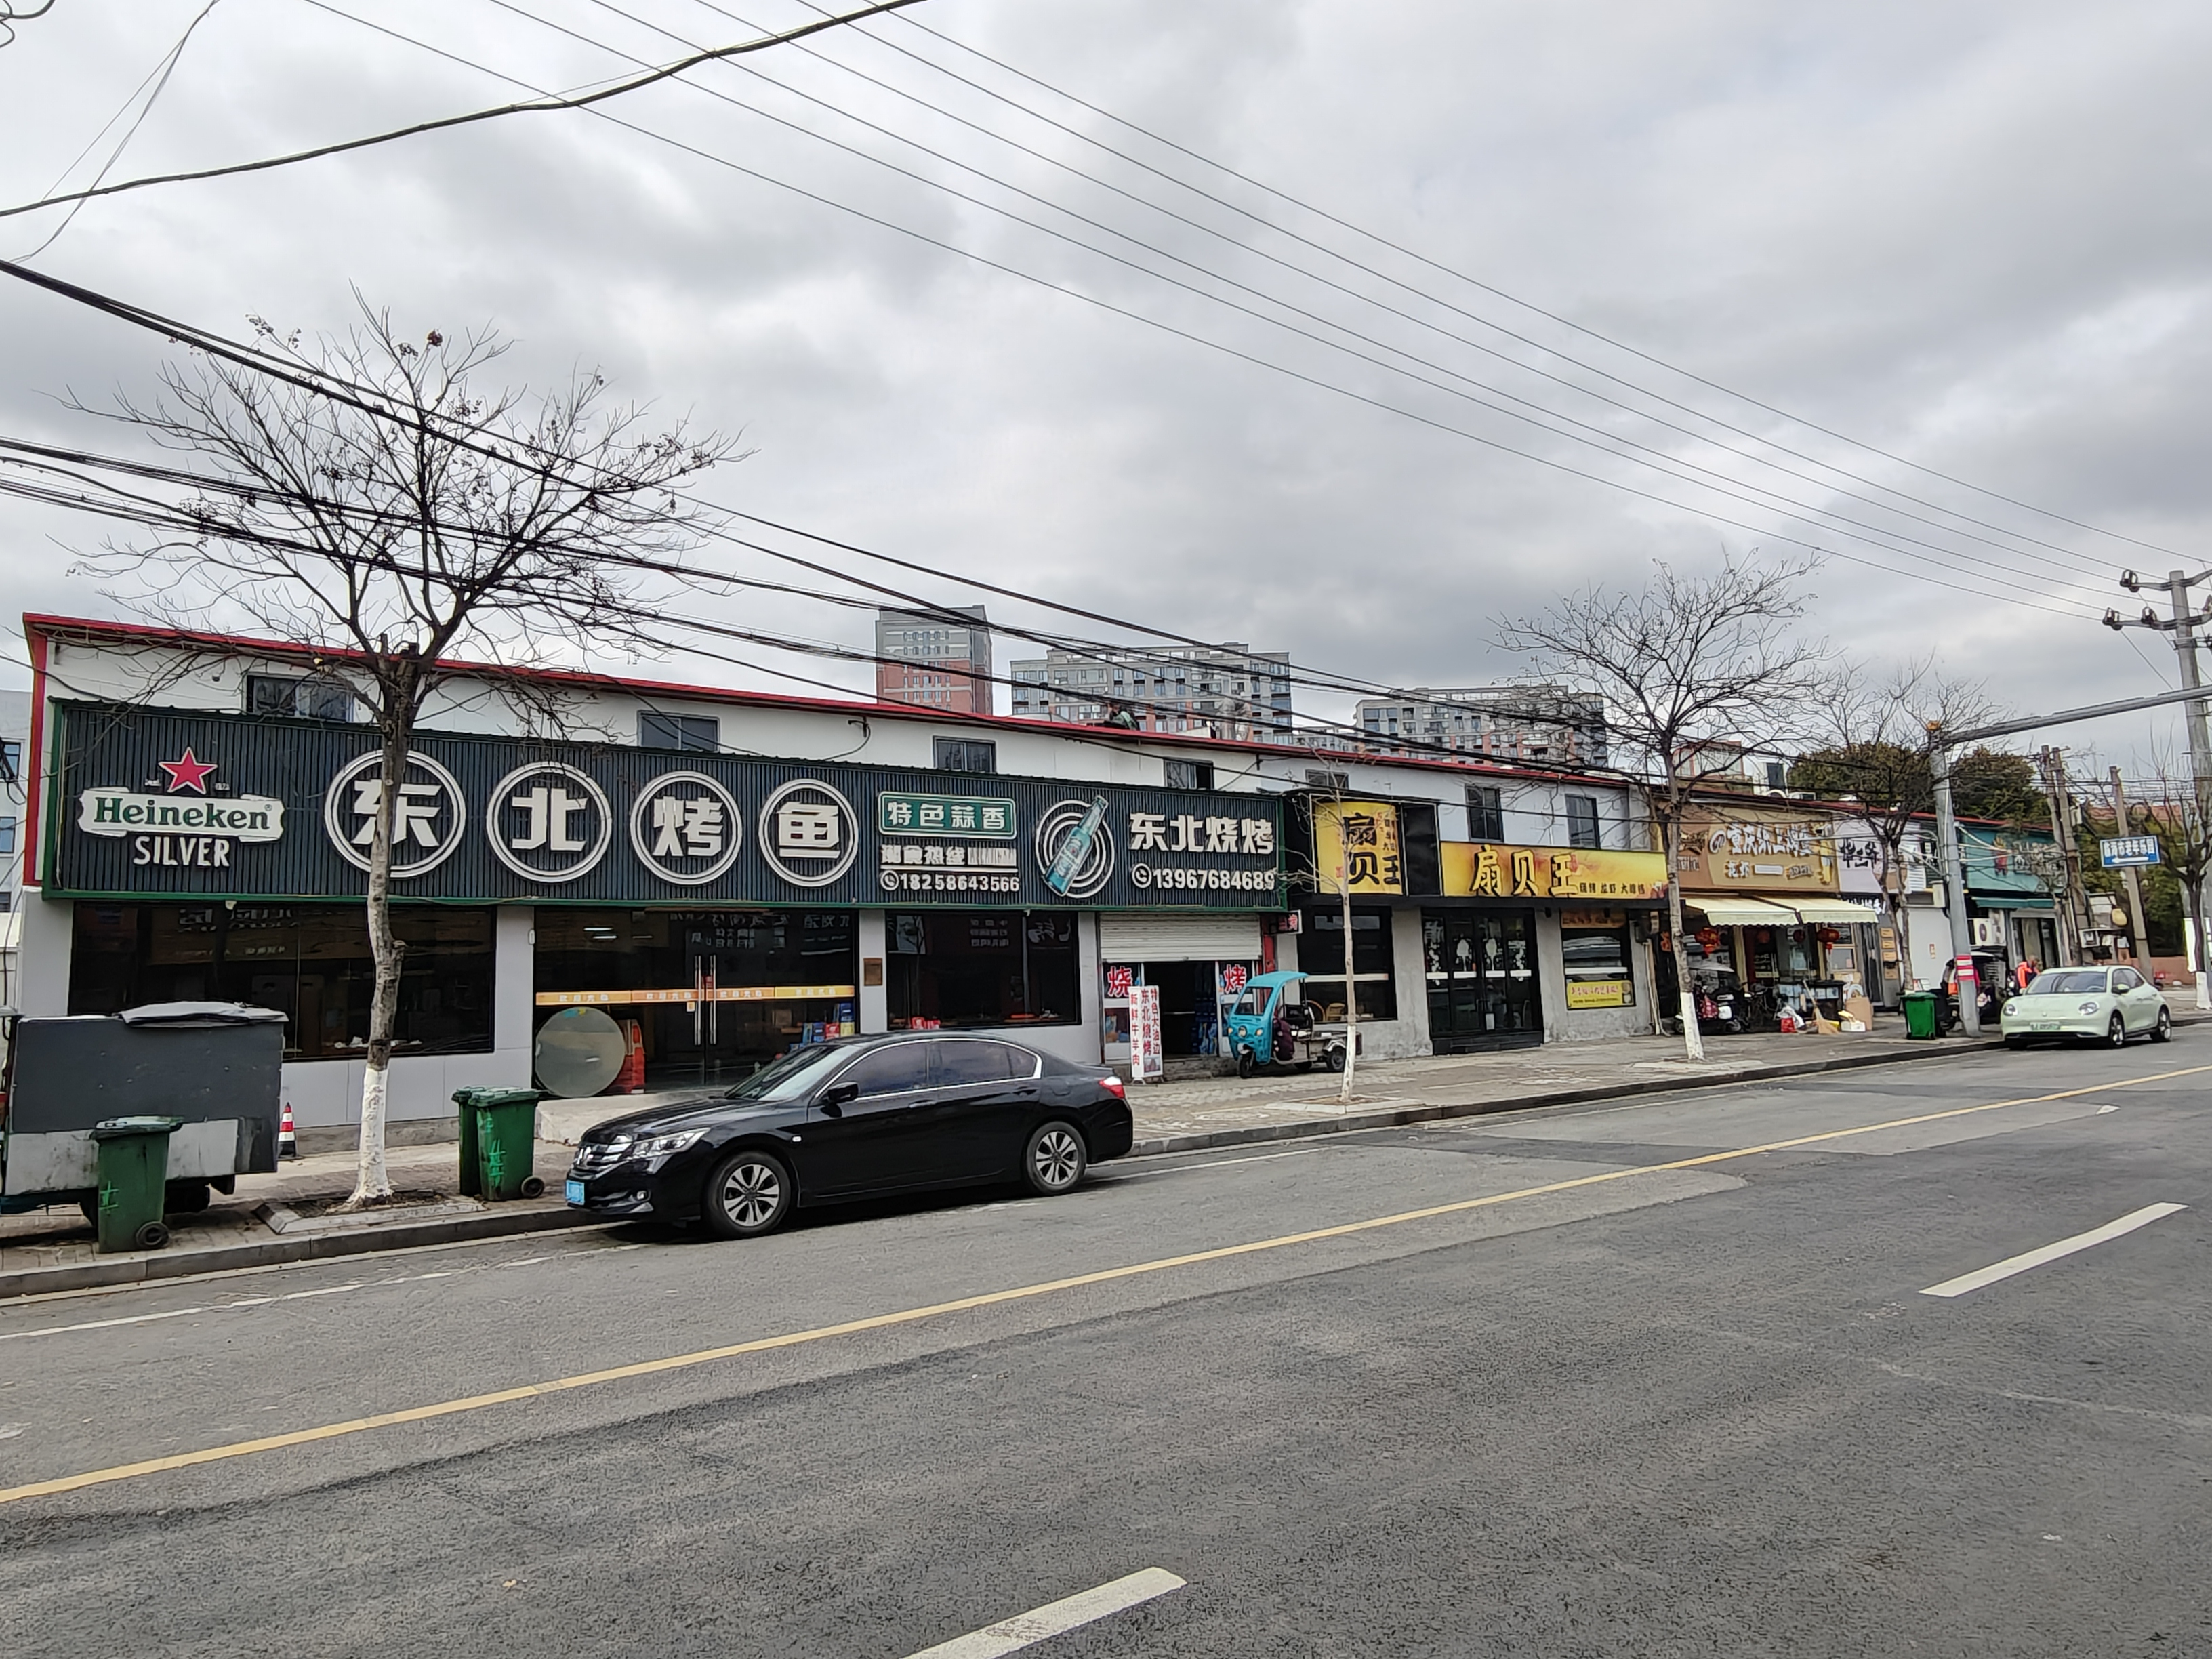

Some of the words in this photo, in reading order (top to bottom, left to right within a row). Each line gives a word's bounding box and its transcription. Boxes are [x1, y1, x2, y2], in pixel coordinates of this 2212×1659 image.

[94, 797, 270, 830] Heineken
[887, 802, 1005, 830] 特色蒜香
[1128, 812, 1274, 854] 东北烧烤
[133, 836, 229, 867] SILVER
[900, 872, 1020, 892] 18258643566
[1153, 868, 1275, 890] 13967684689
[1470, 844, 1578, 897] 扇贝王
[1107, 965, 1133, 997] 烧
[1223, 964, 1247, 994] 烤
